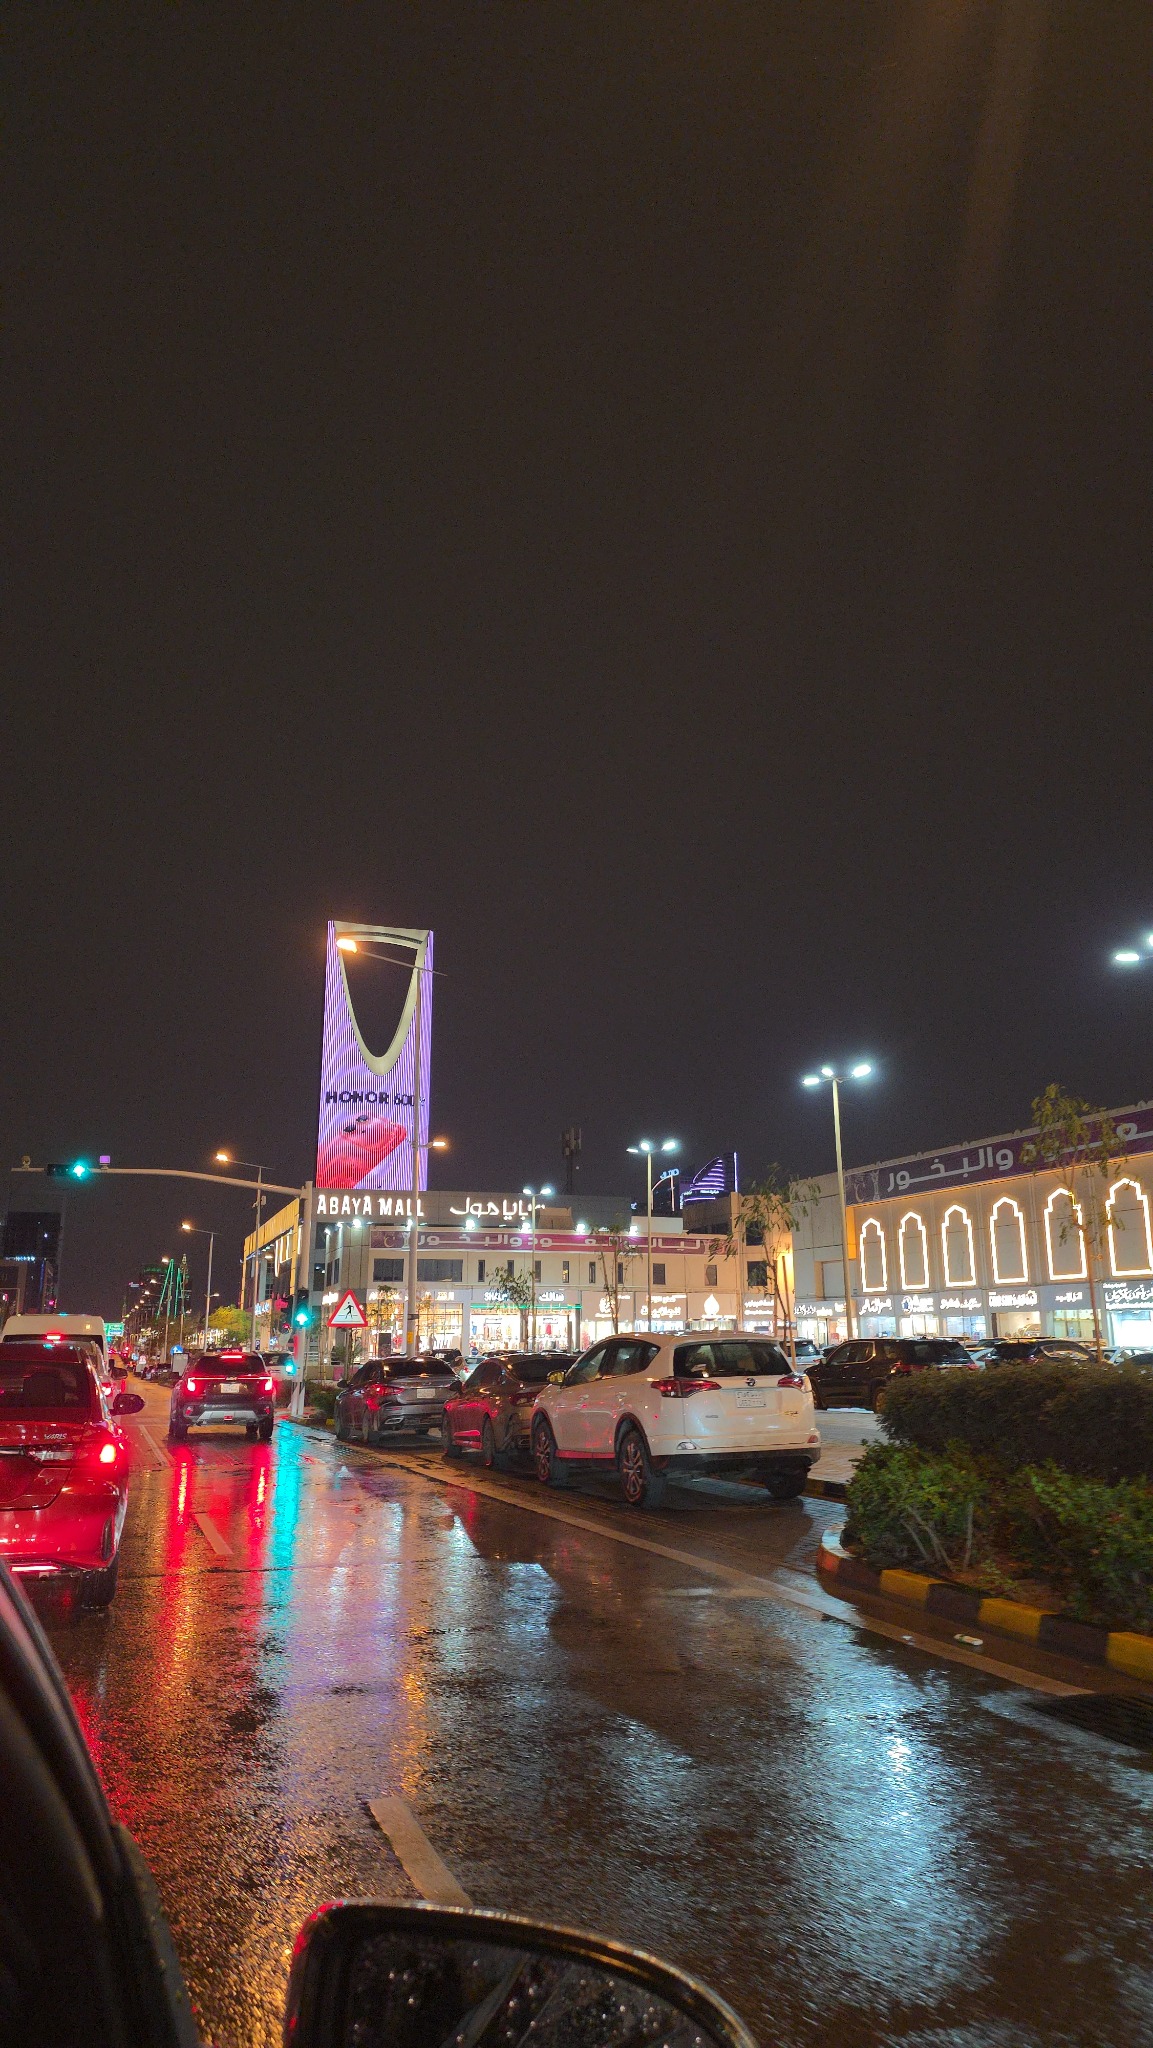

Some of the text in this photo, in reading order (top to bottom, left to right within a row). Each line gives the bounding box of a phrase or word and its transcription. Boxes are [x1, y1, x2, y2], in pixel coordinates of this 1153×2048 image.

[325, 1090, 390, 1104] HONOR
[886, 1146, 1014, 1193] والبخور
[316, 1194, 425, 1217] ABAYA MALL
[449, 1196, 500, 1219] مول
[417, 1233, 523, 1248] والبخور
